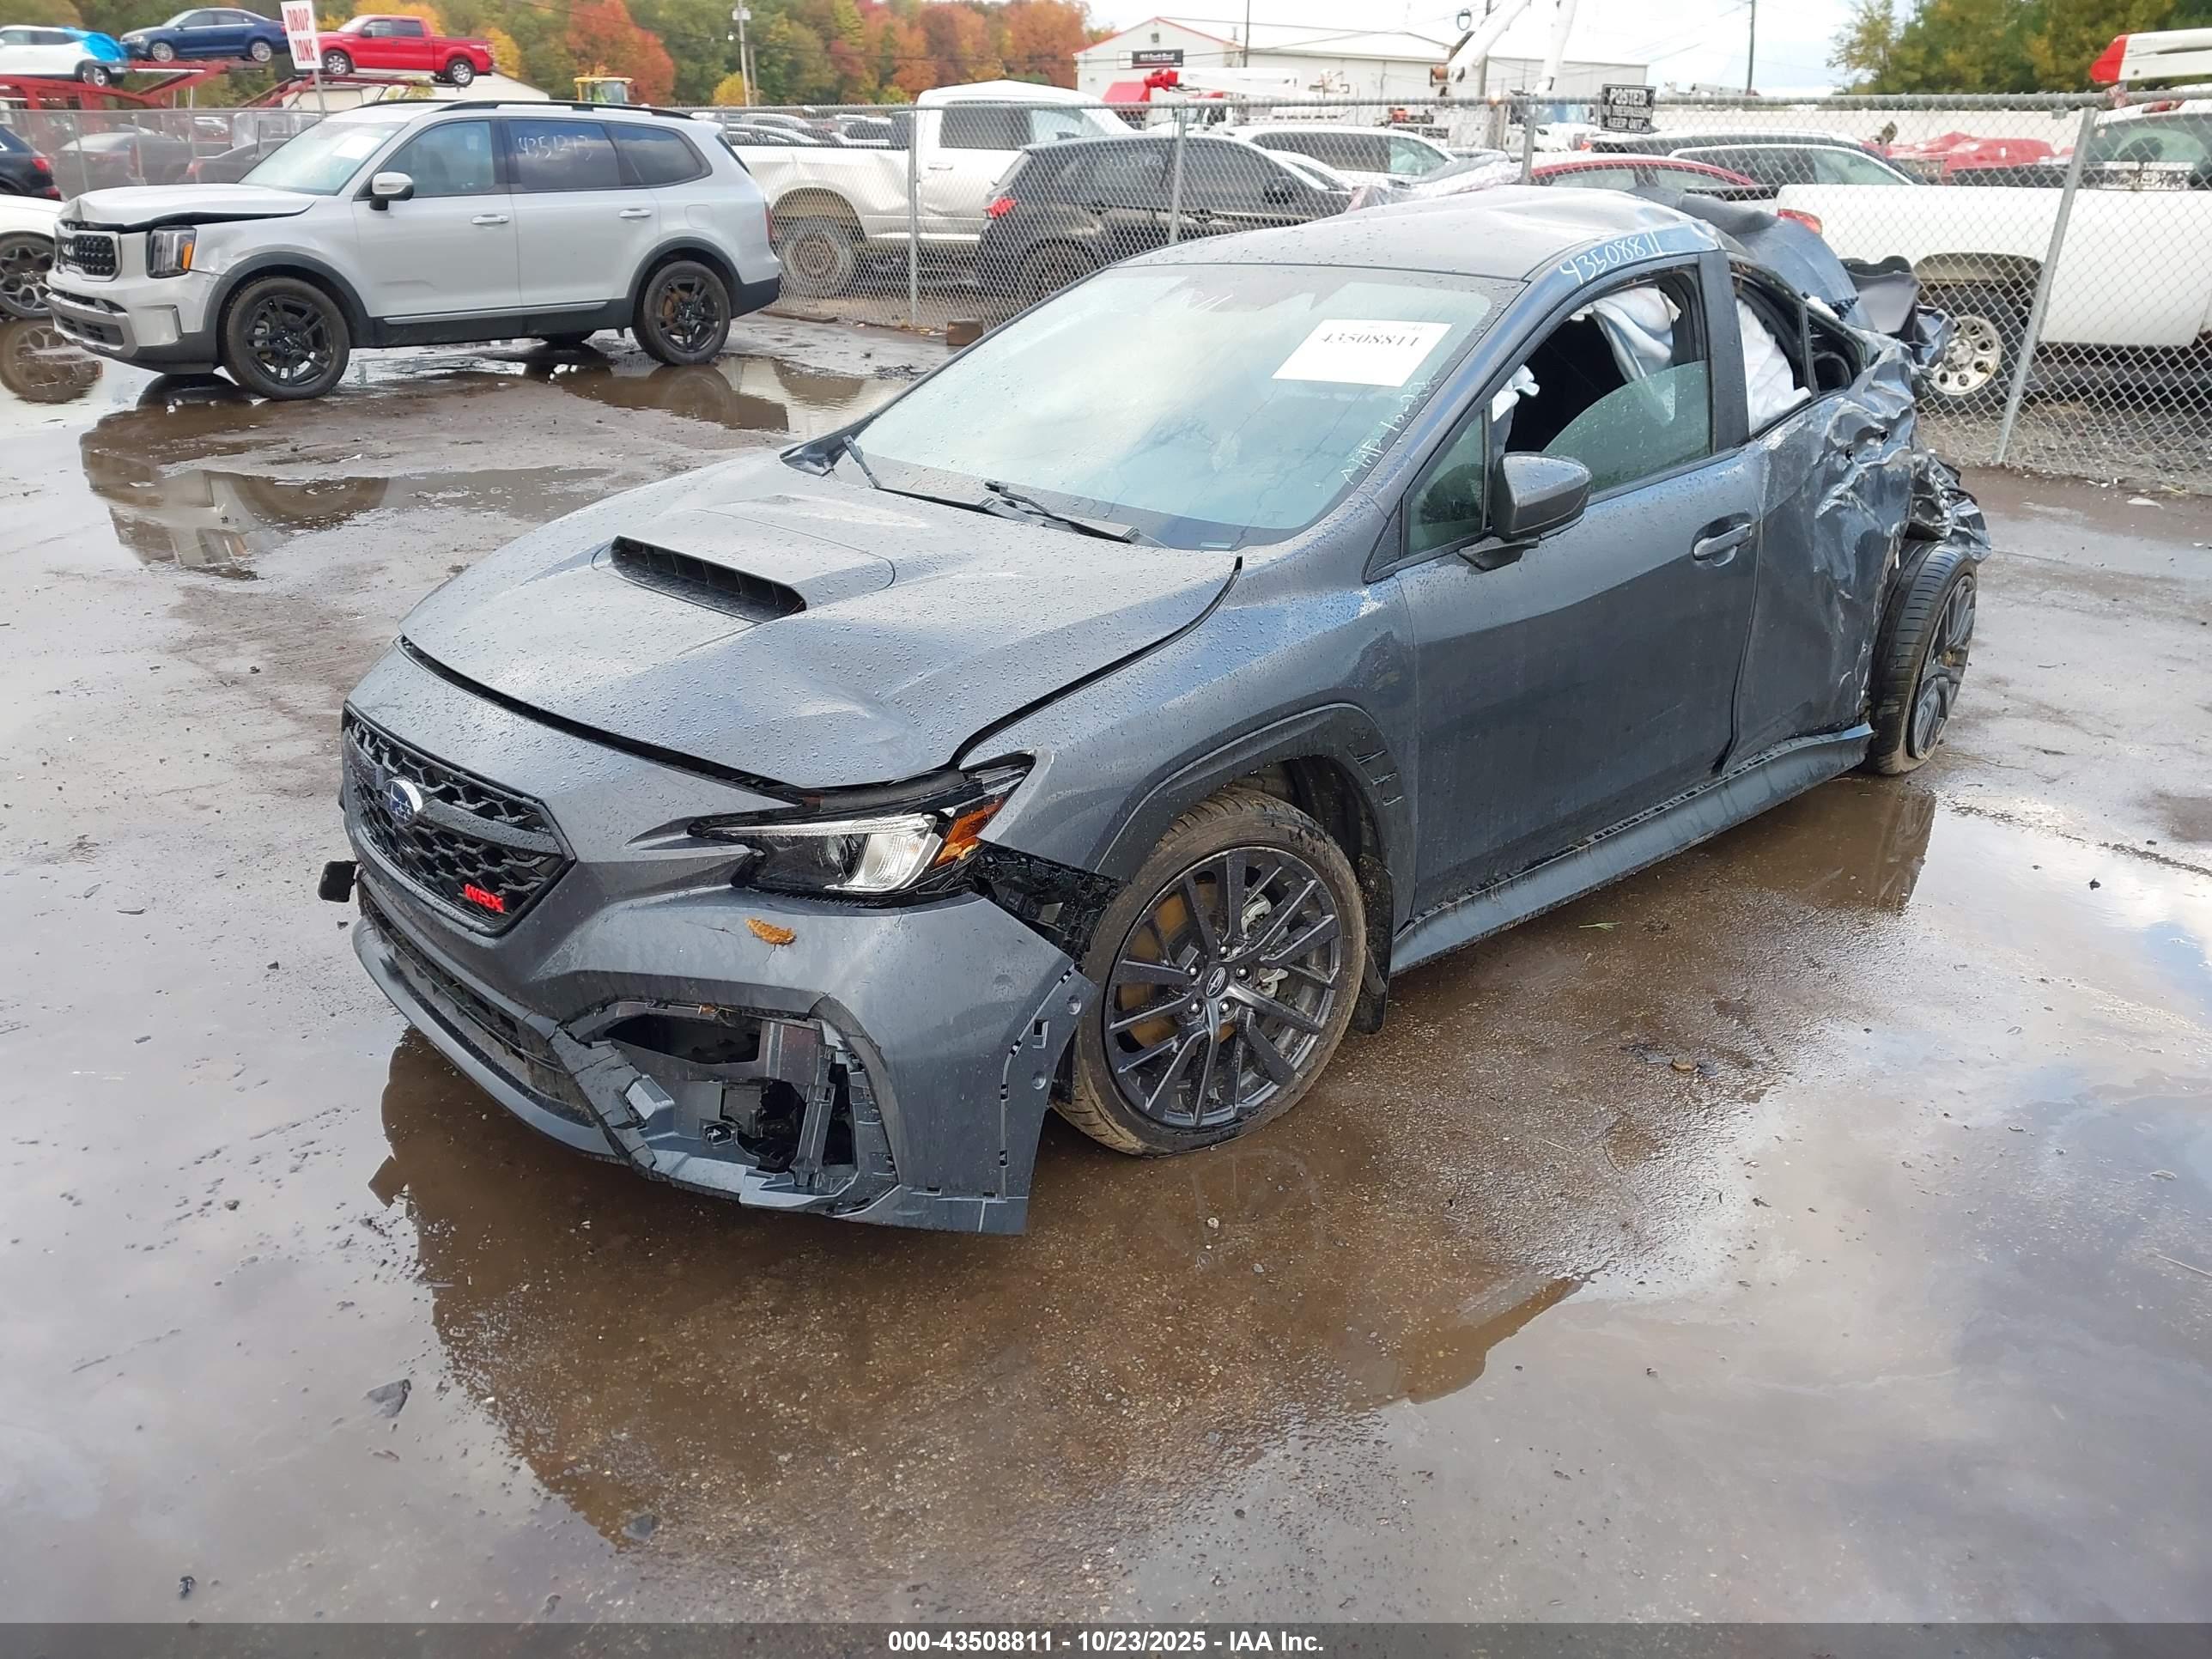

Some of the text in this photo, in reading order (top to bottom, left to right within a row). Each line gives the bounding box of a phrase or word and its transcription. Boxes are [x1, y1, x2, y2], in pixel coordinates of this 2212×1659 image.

[287, 8, 309, 31] DROP
[295, 40, 316, 61] ZONE
[1608, 88, 1647, 105] POSTED
[1559, 230, 1664, 285] 43508811
[465, 884, 505, 914] WRX
